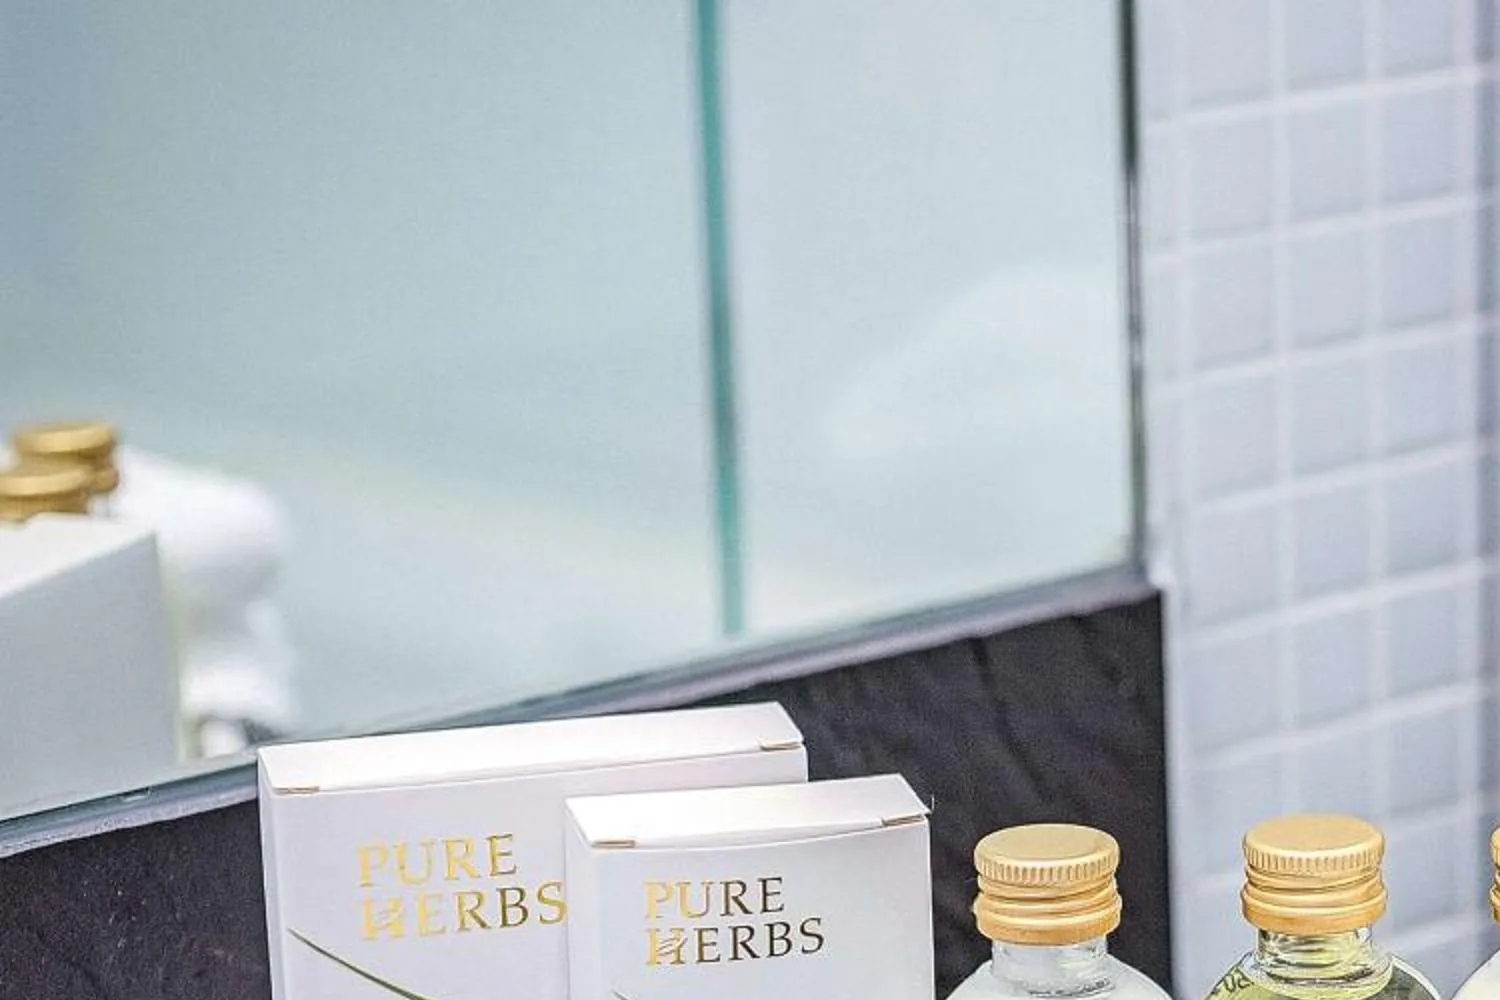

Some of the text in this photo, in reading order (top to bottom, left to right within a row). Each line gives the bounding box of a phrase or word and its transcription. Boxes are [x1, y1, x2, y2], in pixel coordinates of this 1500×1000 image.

[358, 833, 517, 887] PURE
[360, 881, 568, 941] HERBS
[643, 877, 785, 919] PURE
[645, 917, 824, 966] HERBS
